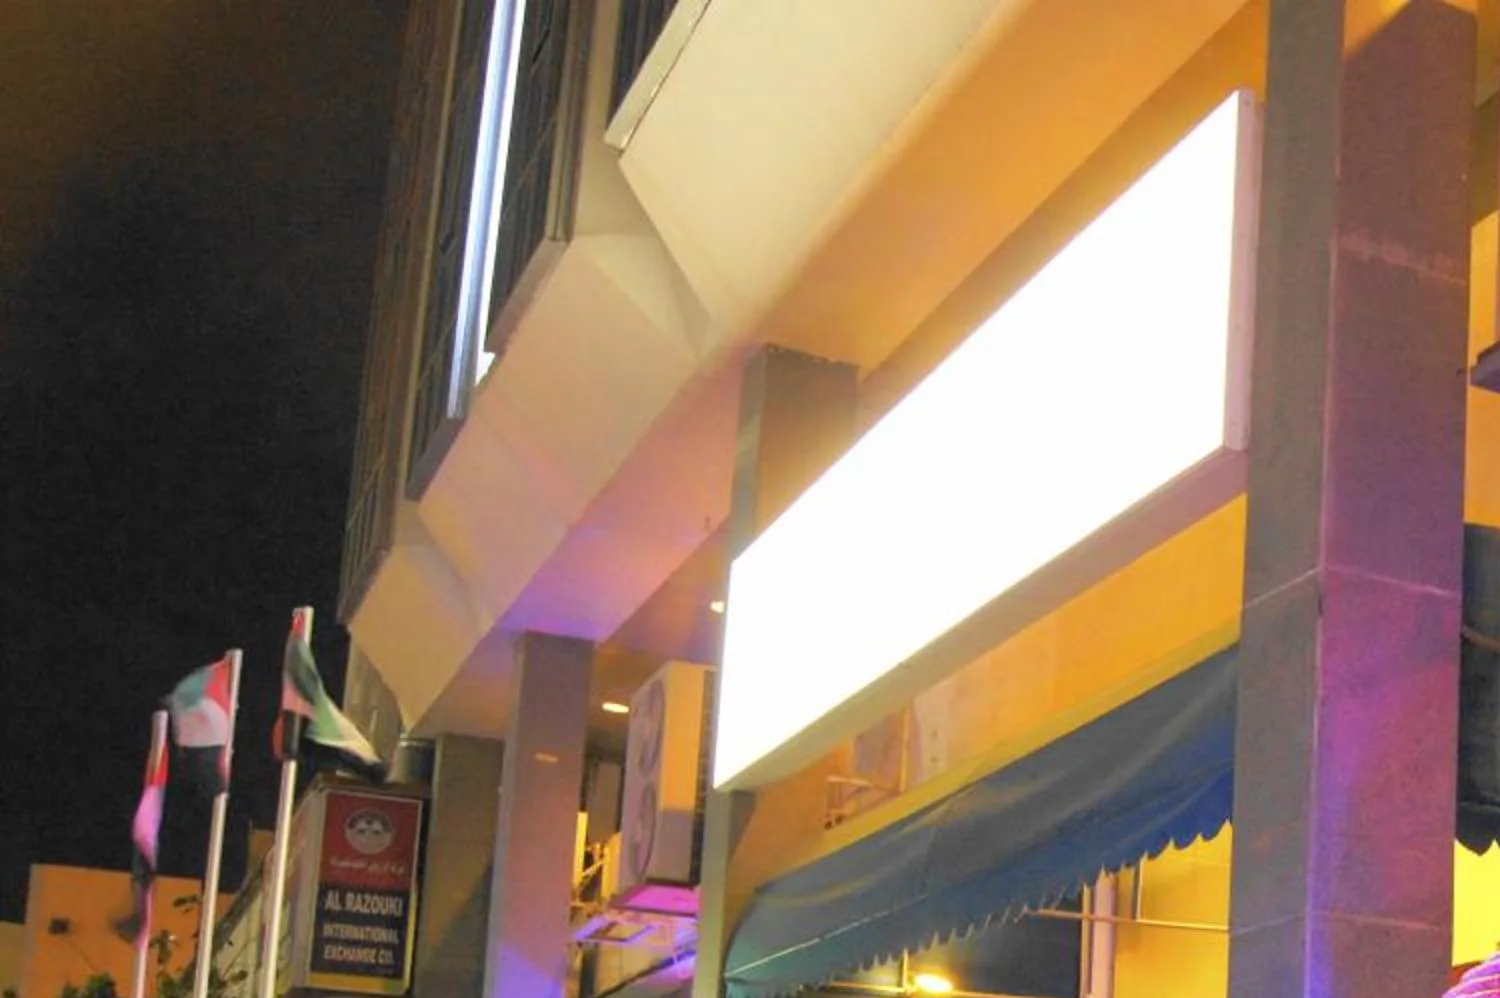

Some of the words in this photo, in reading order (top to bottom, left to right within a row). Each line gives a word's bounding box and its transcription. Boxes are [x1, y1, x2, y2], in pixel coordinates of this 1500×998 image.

[324, 889, 342, 911] AL
[345, 892, 404, 917] RAZOUKI
[323, 922, 400, 944] INTERNATIONAL
[323, 945, 376, 964] EXCHANGE
